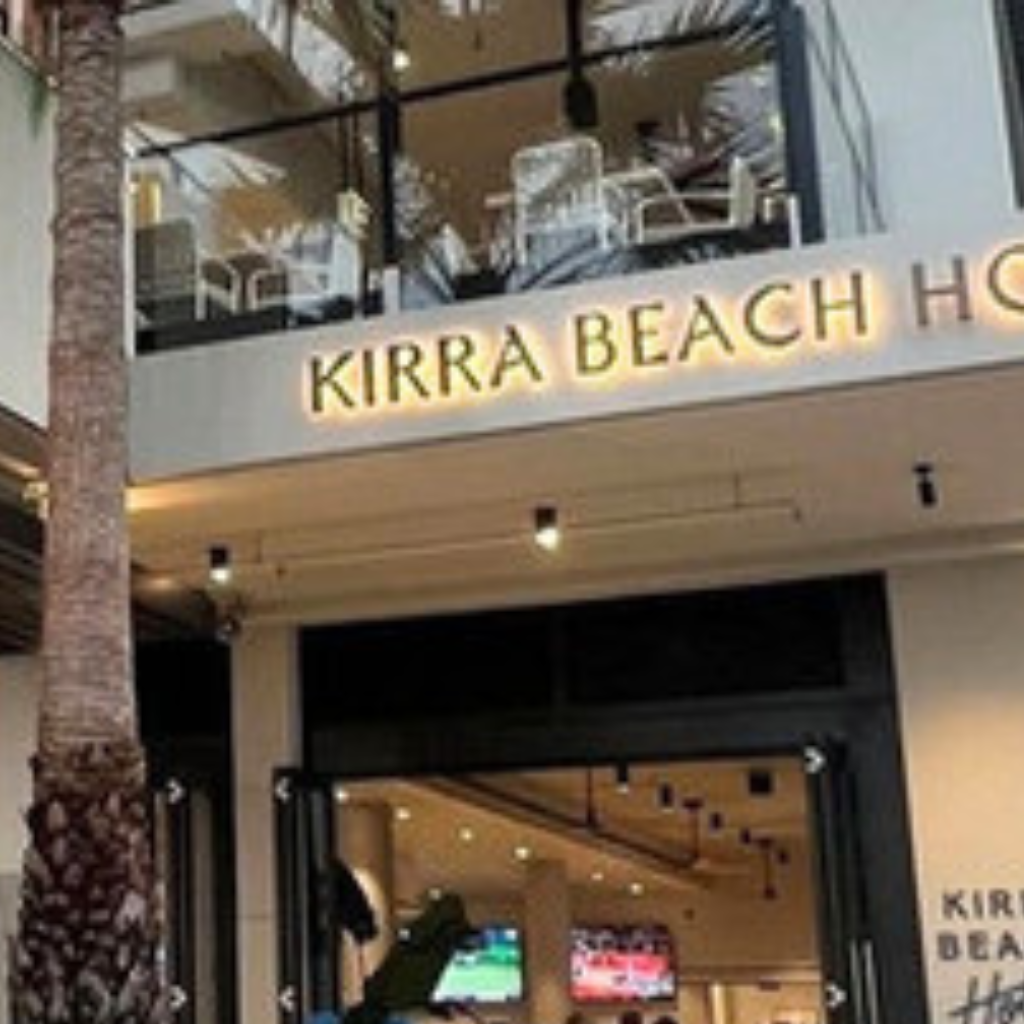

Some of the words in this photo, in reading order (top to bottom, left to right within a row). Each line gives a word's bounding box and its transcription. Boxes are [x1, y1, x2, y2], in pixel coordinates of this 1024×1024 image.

[311, 321, 542, 413] KIRRA
[574, 271, 870, 376] BEACH
[942, 886, 1024, 920] KIR
